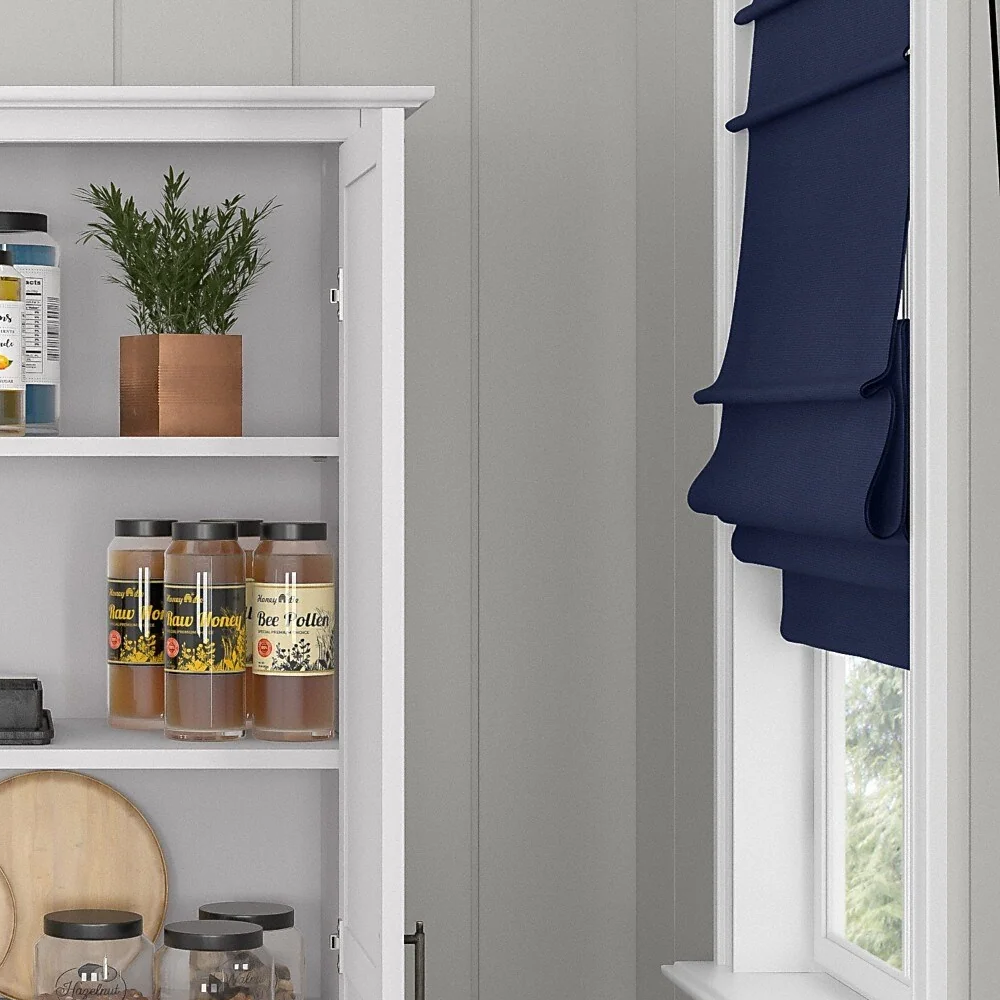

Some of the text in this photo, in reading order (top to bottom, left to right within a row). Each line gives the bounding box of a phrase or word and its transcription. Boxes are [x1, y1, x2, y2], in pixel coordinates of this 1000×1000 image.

[257, 594, 277, 605] Honey
[109, 603, 135, 620] Raw
[256, 610, 280, 627] Bee
[283, 611, 329, 627] Pollen
[166, 610, 194, 627] Raw
[199, 611, 242, 631] Honey
[56, 980, 120, 1000] Hazelnut
